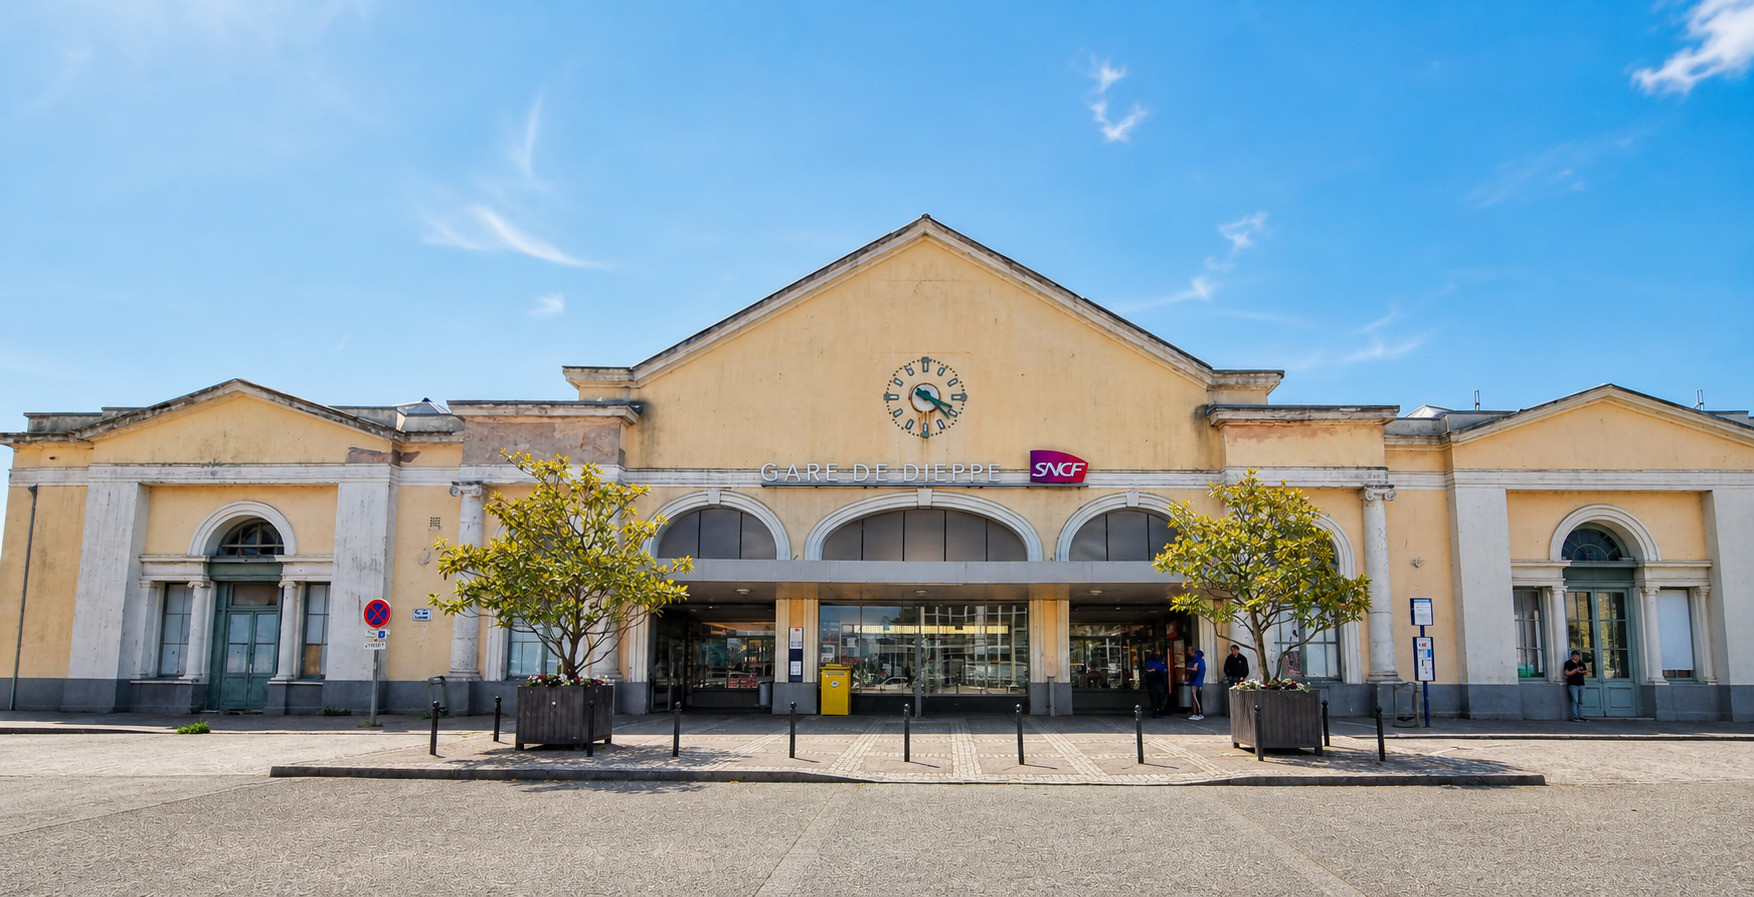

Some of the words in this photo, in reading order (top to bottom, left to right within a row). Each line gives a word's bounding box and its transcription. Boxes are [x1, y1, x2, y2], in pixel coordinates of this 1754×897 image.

[761, 463, 839, 482] GARE
[853, 463, 888, 482] DE
[904, 463, 1001, 482] DIEPPE
[1032, 462, 1086, 477] SNCF
